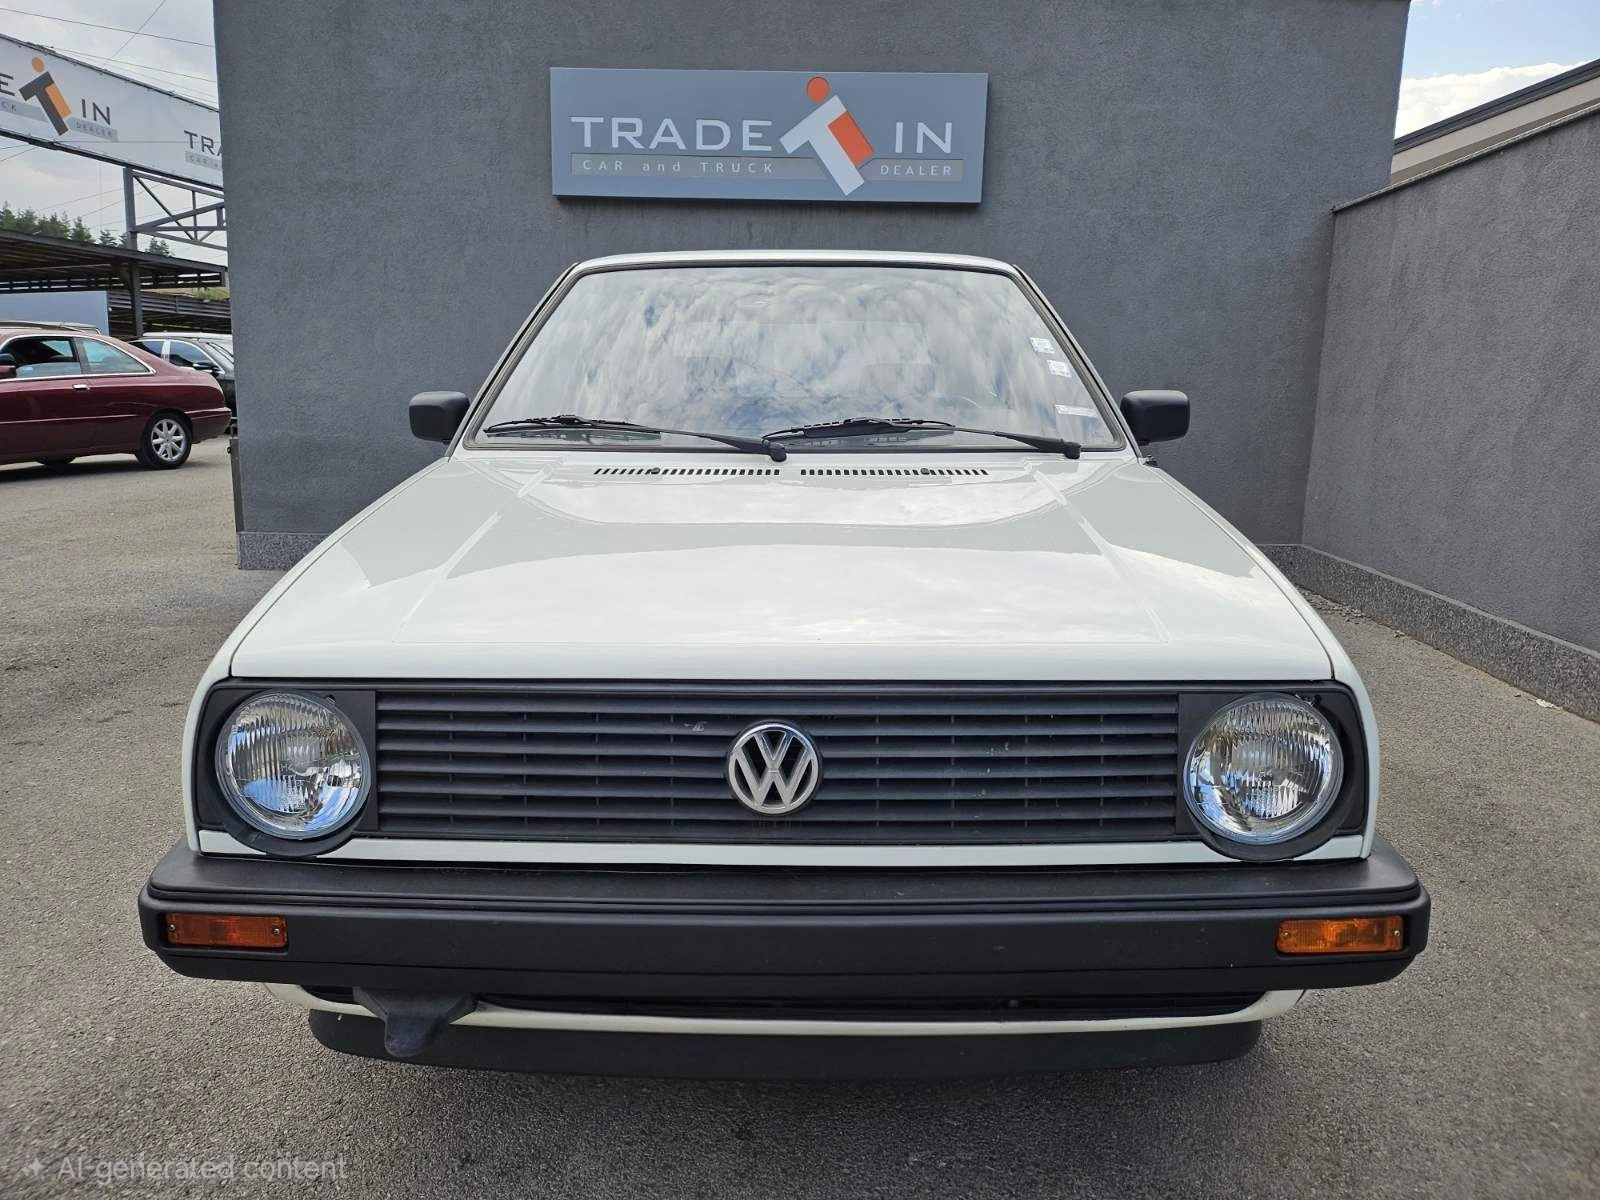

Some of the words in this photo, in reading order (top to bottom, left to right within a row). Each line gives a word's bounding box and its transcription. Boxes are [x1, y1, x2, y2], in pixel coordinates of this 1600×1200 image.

[81, 98, 111, 126] IN
[571, 116, 773, 151] TRADE
[895, 121, 953, 154] IN
[582, 159, 623, 171] CAR
[642, 160, 681, 172] and
[700, 161, 773, 173] TRUCK
[880, 165, 952, 176] DEALER
